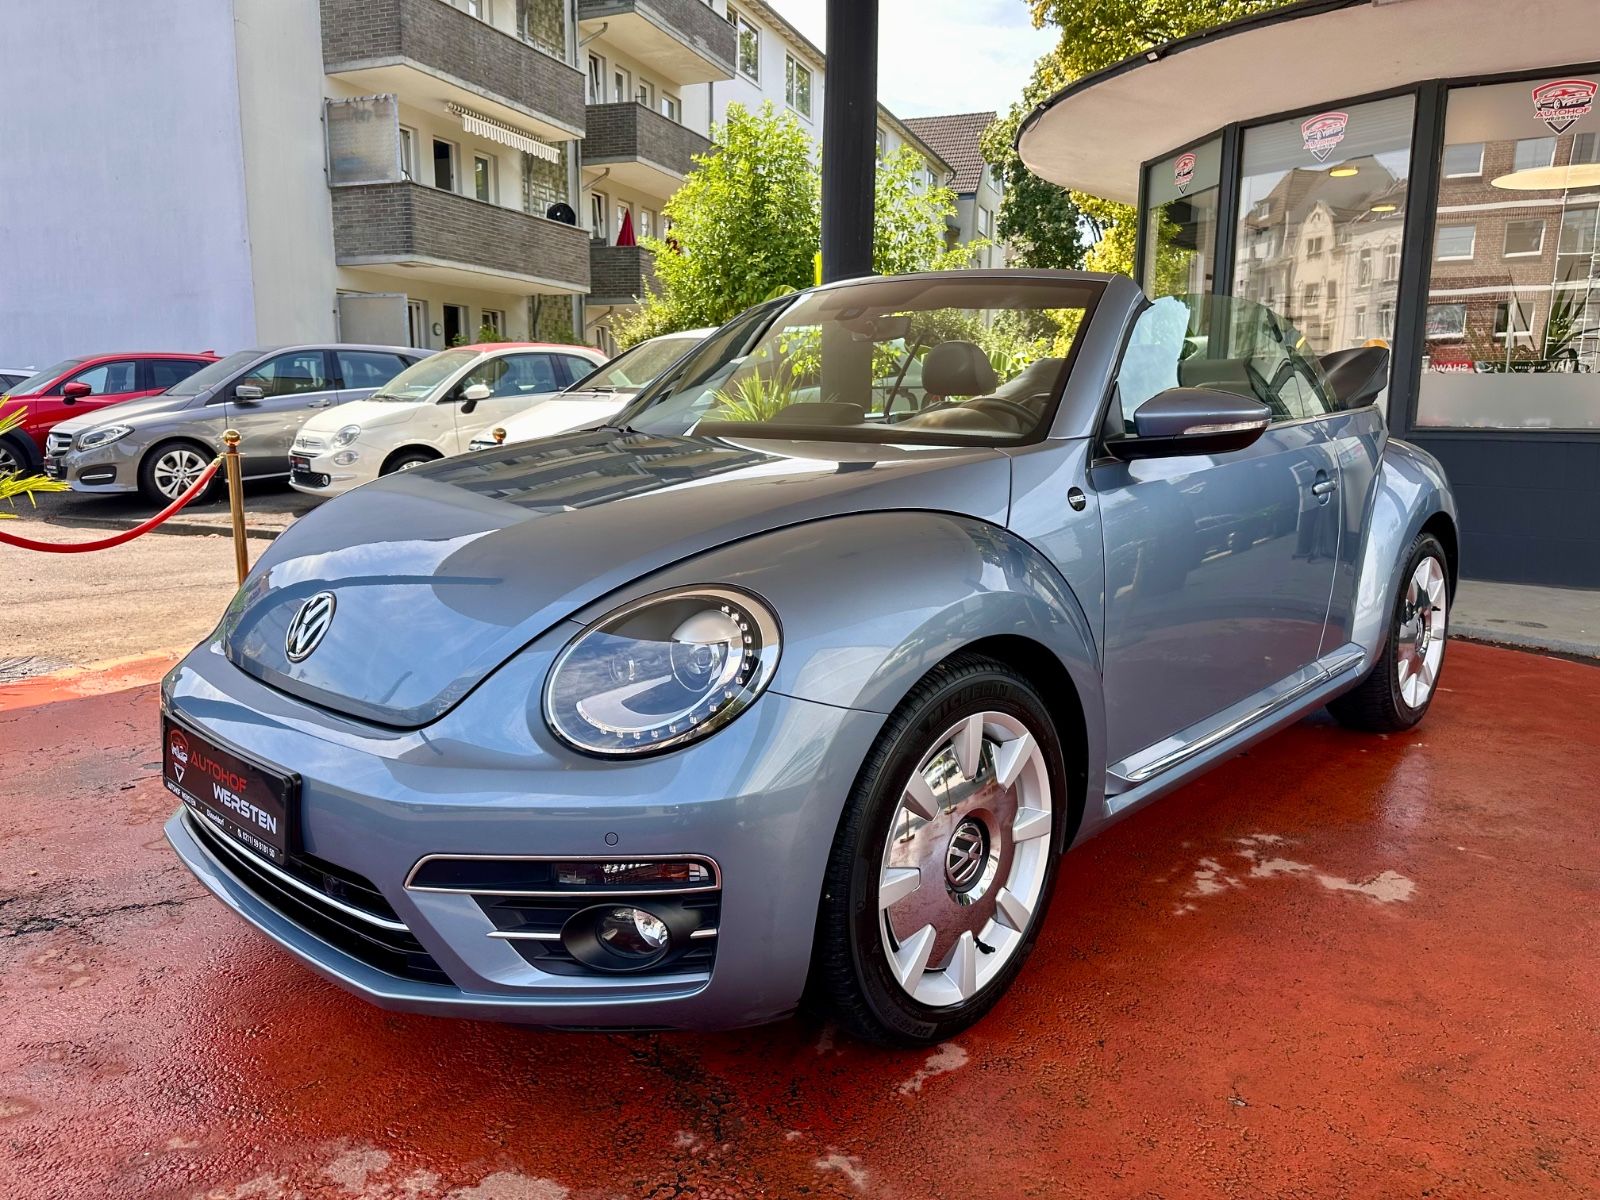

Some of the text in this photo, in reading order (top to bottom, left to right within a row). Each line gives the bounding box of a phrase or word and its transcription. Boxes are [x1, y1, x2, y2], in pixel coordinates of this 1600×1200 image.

[1534, 106, 1591, 118] AUTOHOF
[191, 751, 247, 793] AUTOHOF
[213, 782, 277, 835] WERSTEN
